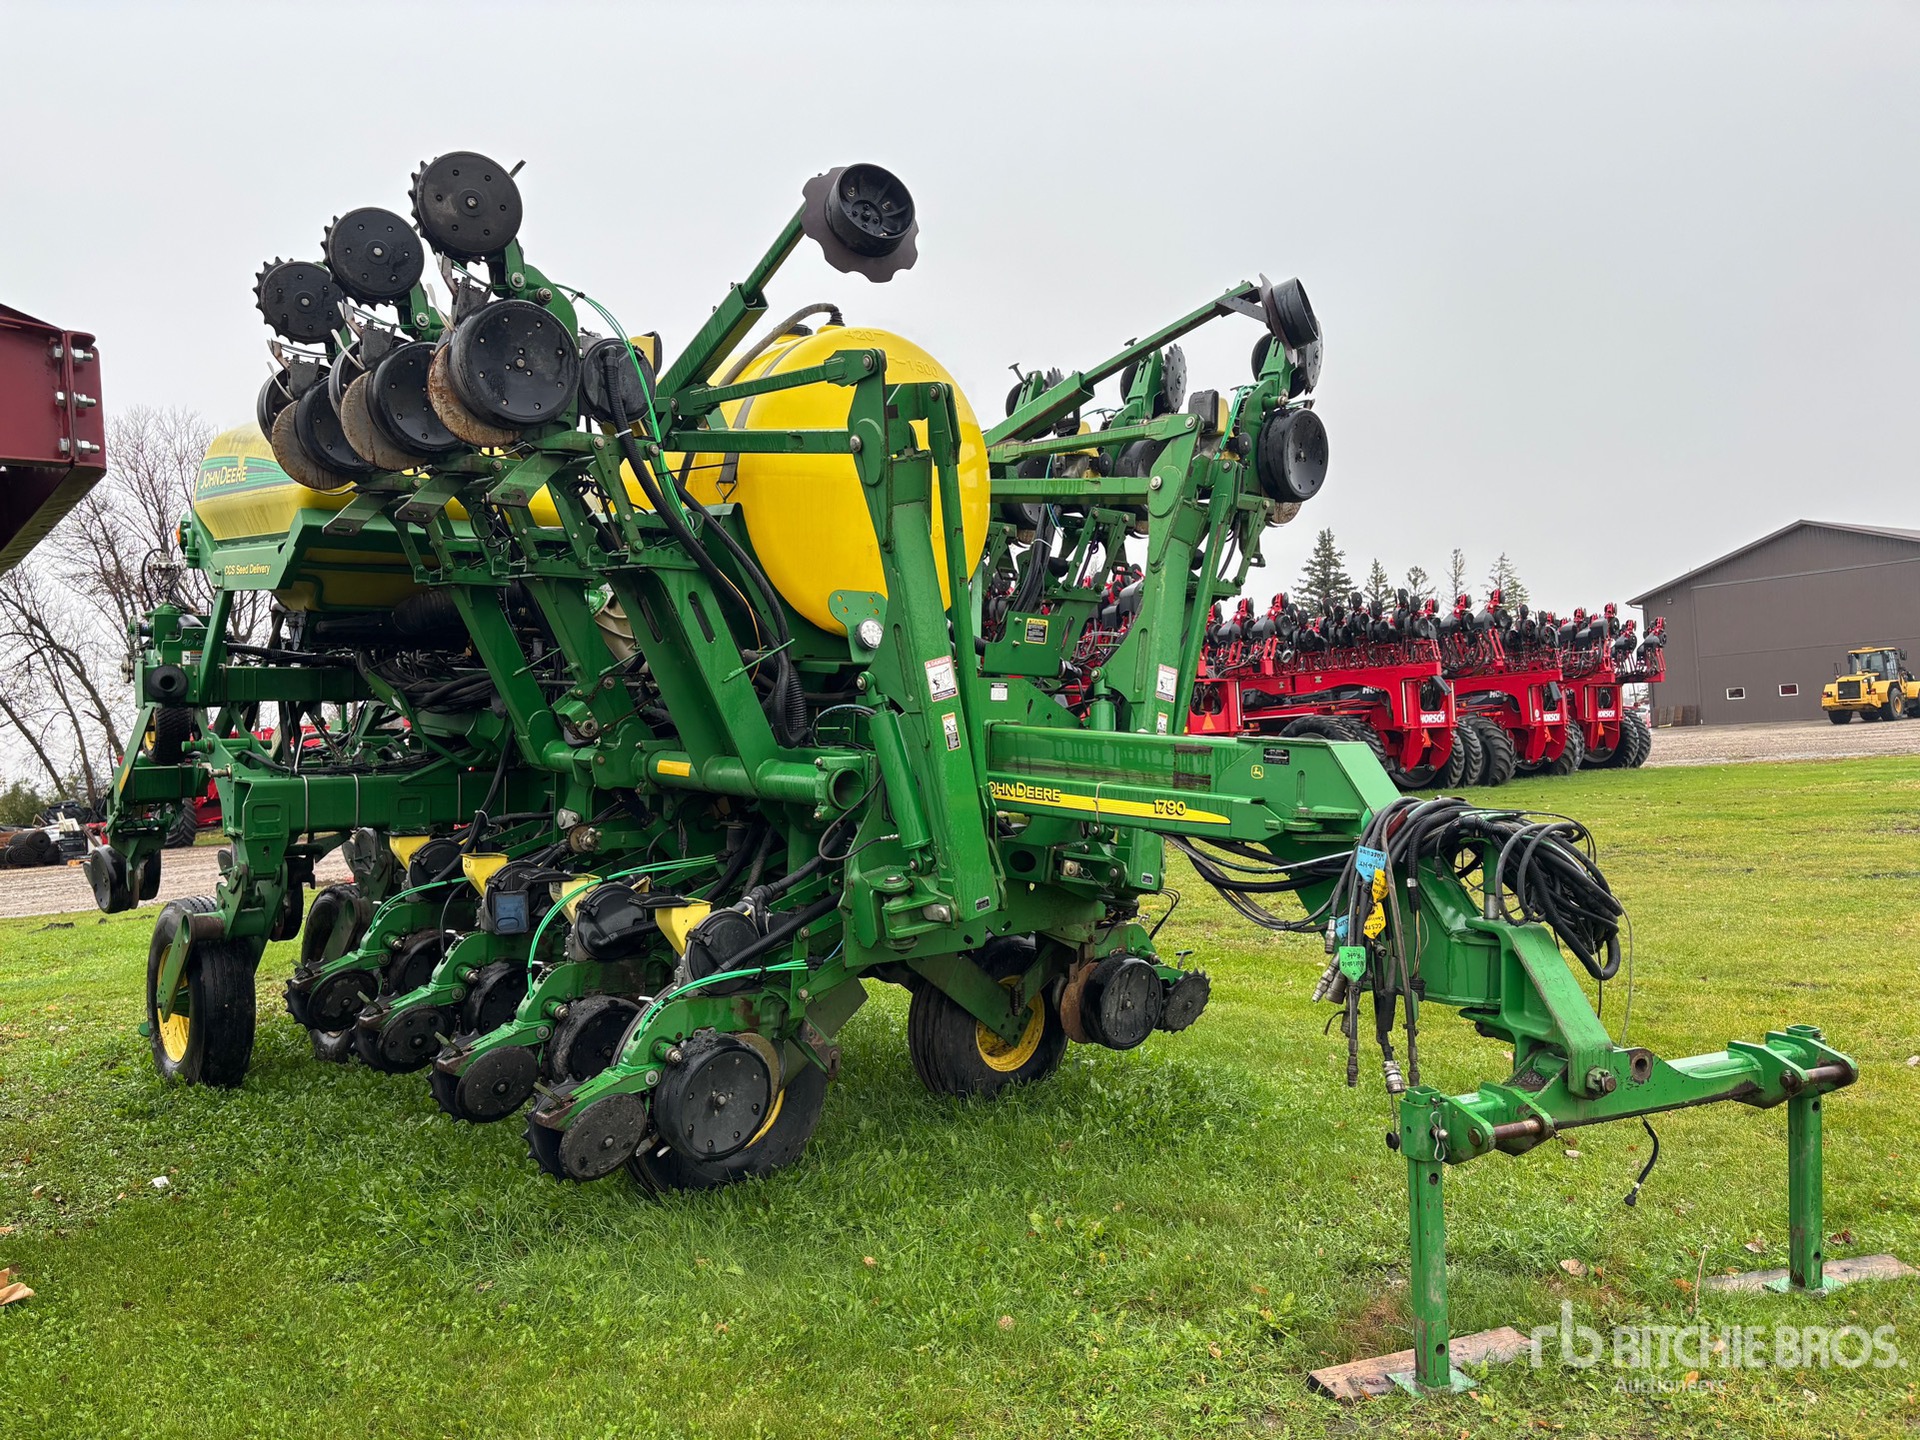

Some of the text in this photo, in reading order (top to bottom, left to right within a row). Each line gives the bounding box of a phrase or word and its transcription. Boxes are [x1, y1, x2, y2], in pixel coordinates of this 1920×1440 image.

[845, 330, 875, 341] 420
[200, 465, 248, 489] JOHN DEERE
[225, 564, 271, 576] CCS Seed Delivery
[1420, 711, 1446, 724] HORSCH
[988, 781, 1061, 802] OHN DEERE
[1153, 799, 1186, 816] 1790
